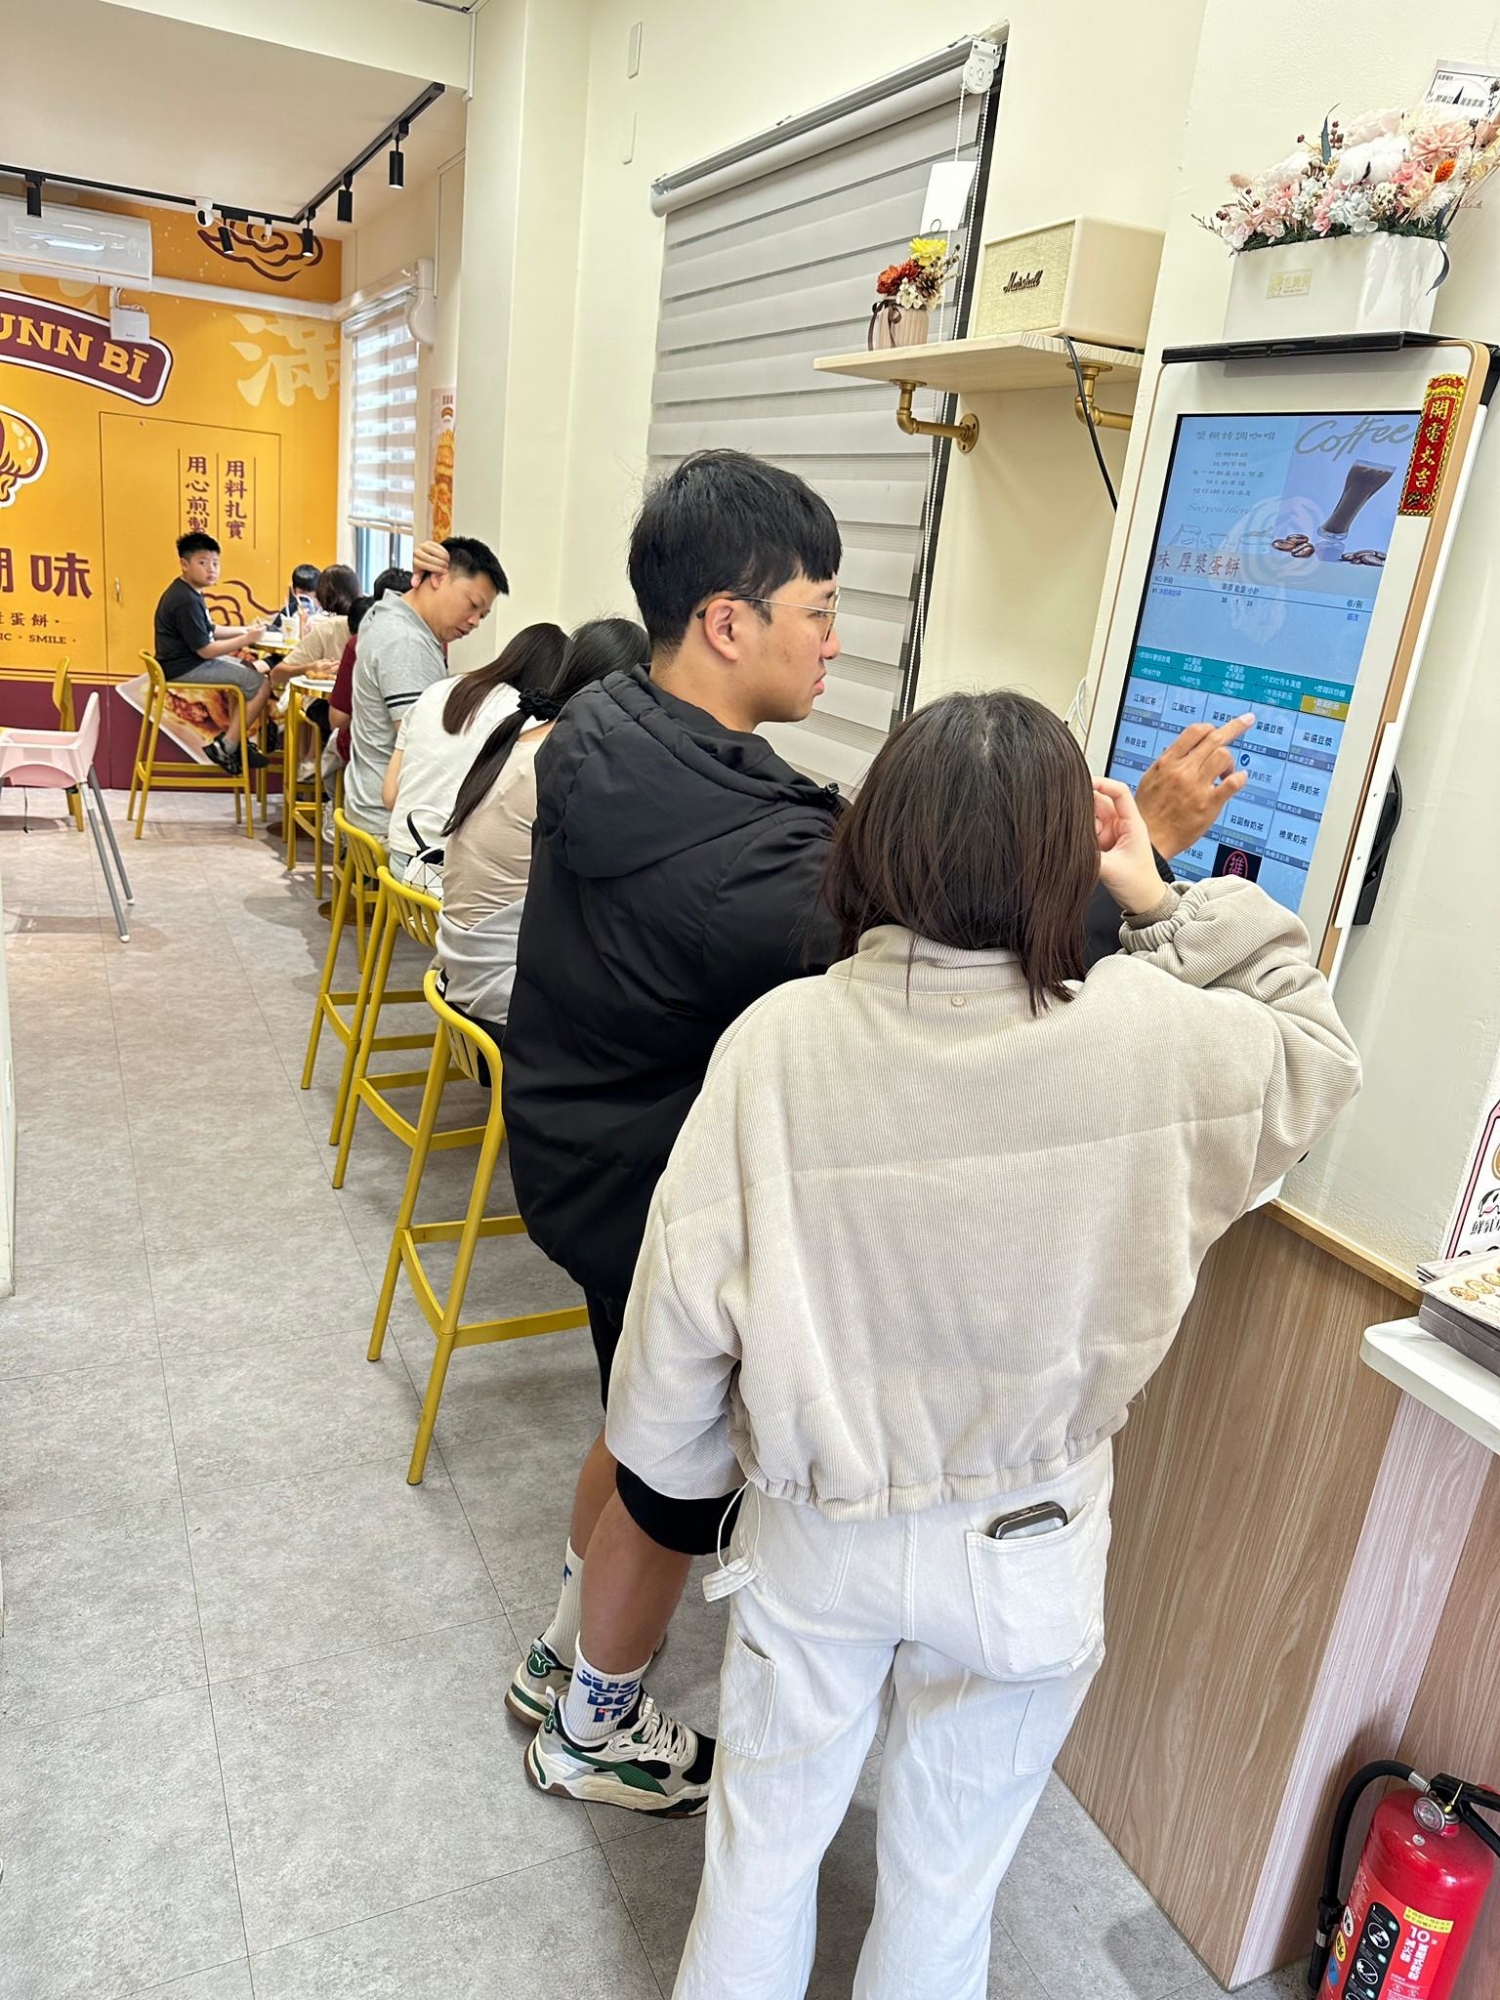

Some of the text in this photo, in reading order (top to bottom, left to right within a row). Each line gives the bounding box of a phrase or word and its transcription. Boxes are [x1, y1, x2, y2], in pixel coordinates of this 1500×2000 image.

[1003, 269, 1044, 293] Marshall
[1295, 415, 1416, 461] Coffee
[225, 460, 248, 540] 用料扎實
[1178, 551, 1240, 577] 厚漿蛋餅
[29, 634, 67, 644] SMILE
[1291, 781, 1320, 797] 經典奶茶
[1410, 1925, 1430, 1943] 10
